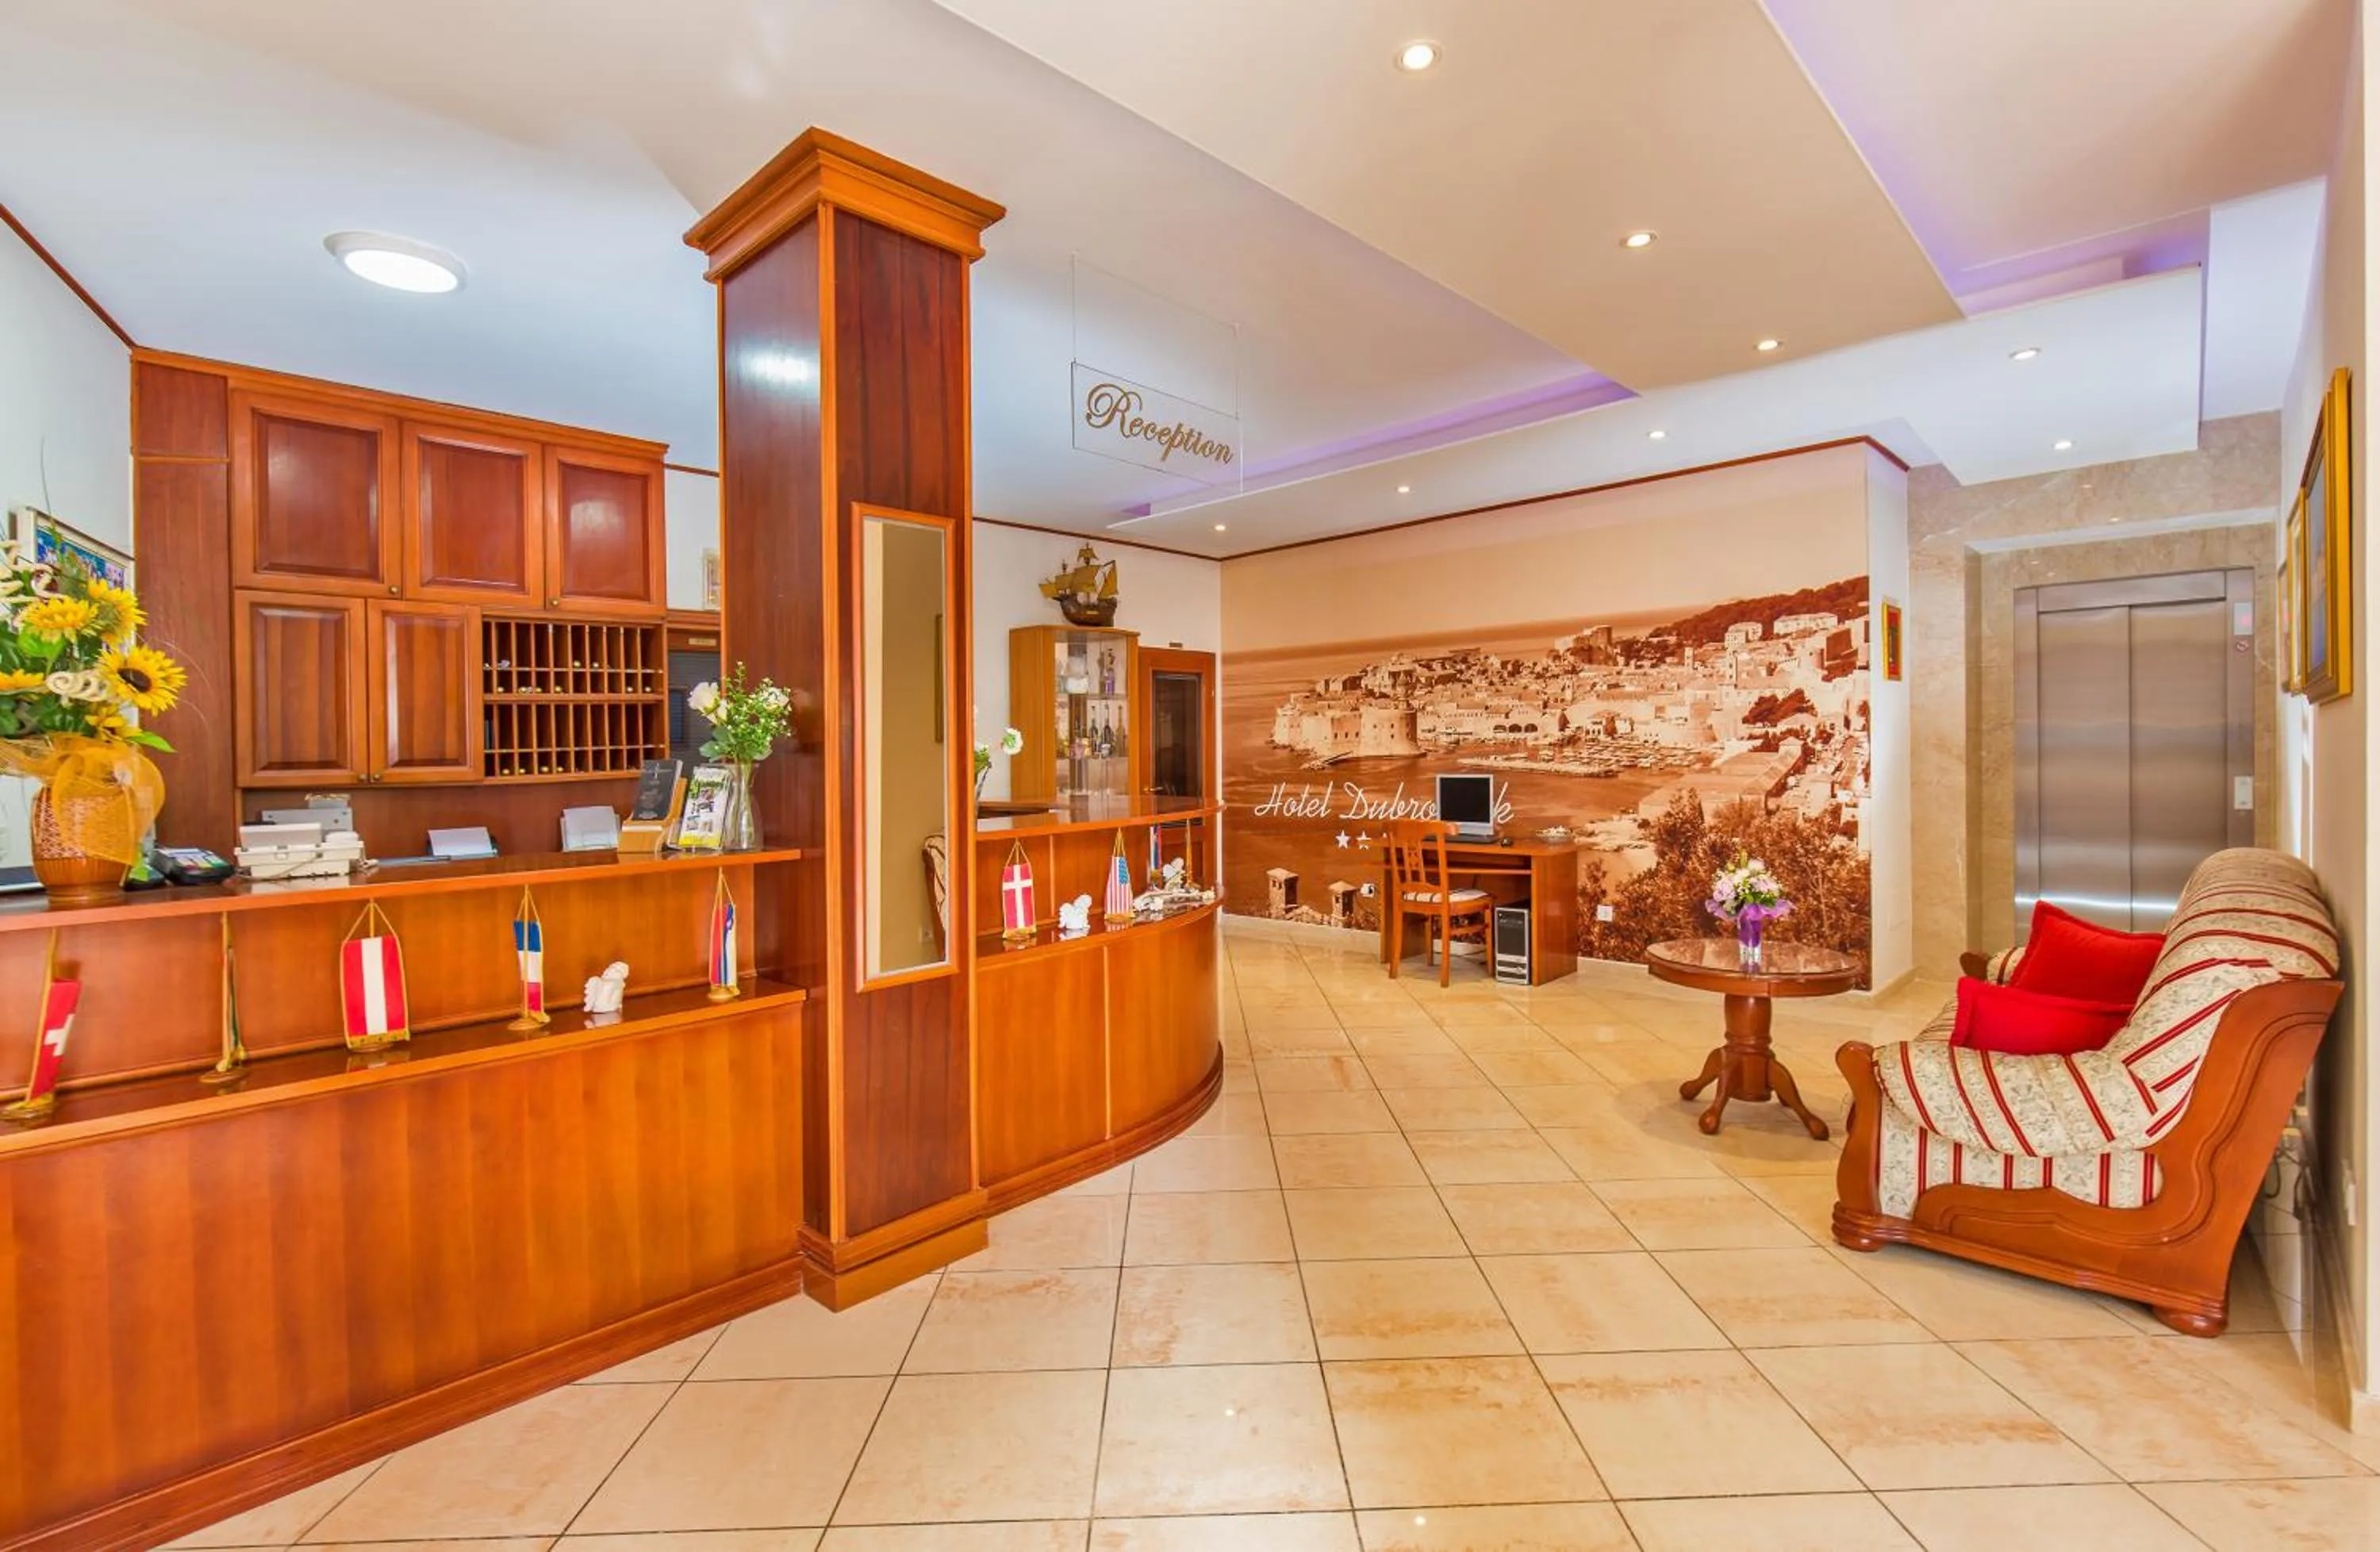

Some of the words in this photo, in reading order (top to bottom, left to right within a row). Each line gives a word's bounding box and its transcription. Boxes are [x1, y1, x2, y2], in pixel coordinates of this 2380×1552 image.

[1085, 382, 1234, 464] Reception
[1254, 780, 1334, 818] Hotel
[1338, 780, 1514, 824] Dubrok
